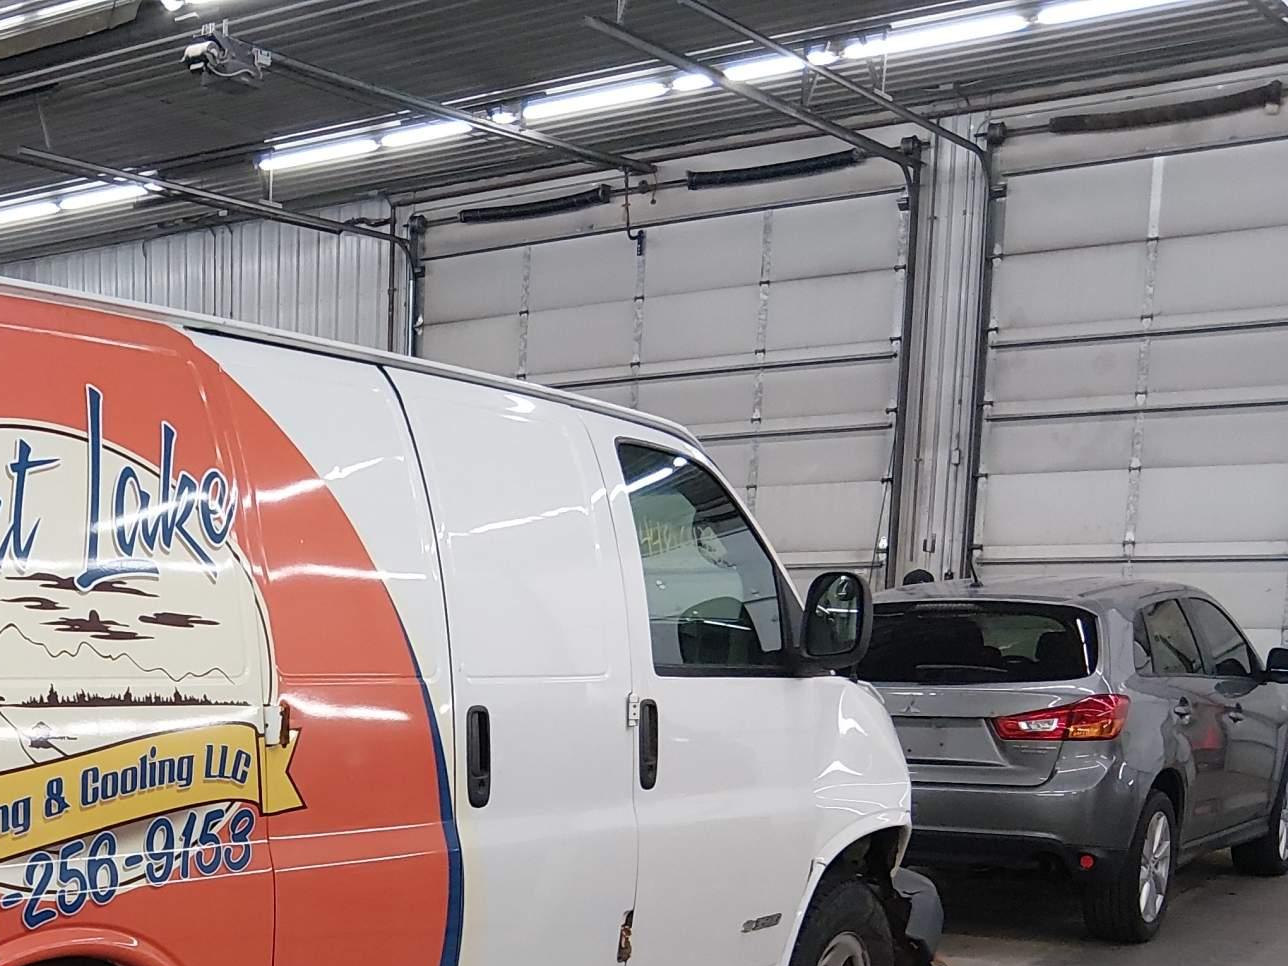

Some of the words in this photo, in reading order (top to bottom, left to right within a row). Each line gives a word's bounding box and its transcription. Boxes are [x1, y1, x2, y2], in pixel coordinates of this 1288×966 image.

[75, 385, 236, 589] Lake
[44, 776, 71, 818] &
[80, 747, 195, 807] Cooling
[205, 744, 252, 784] LLC
